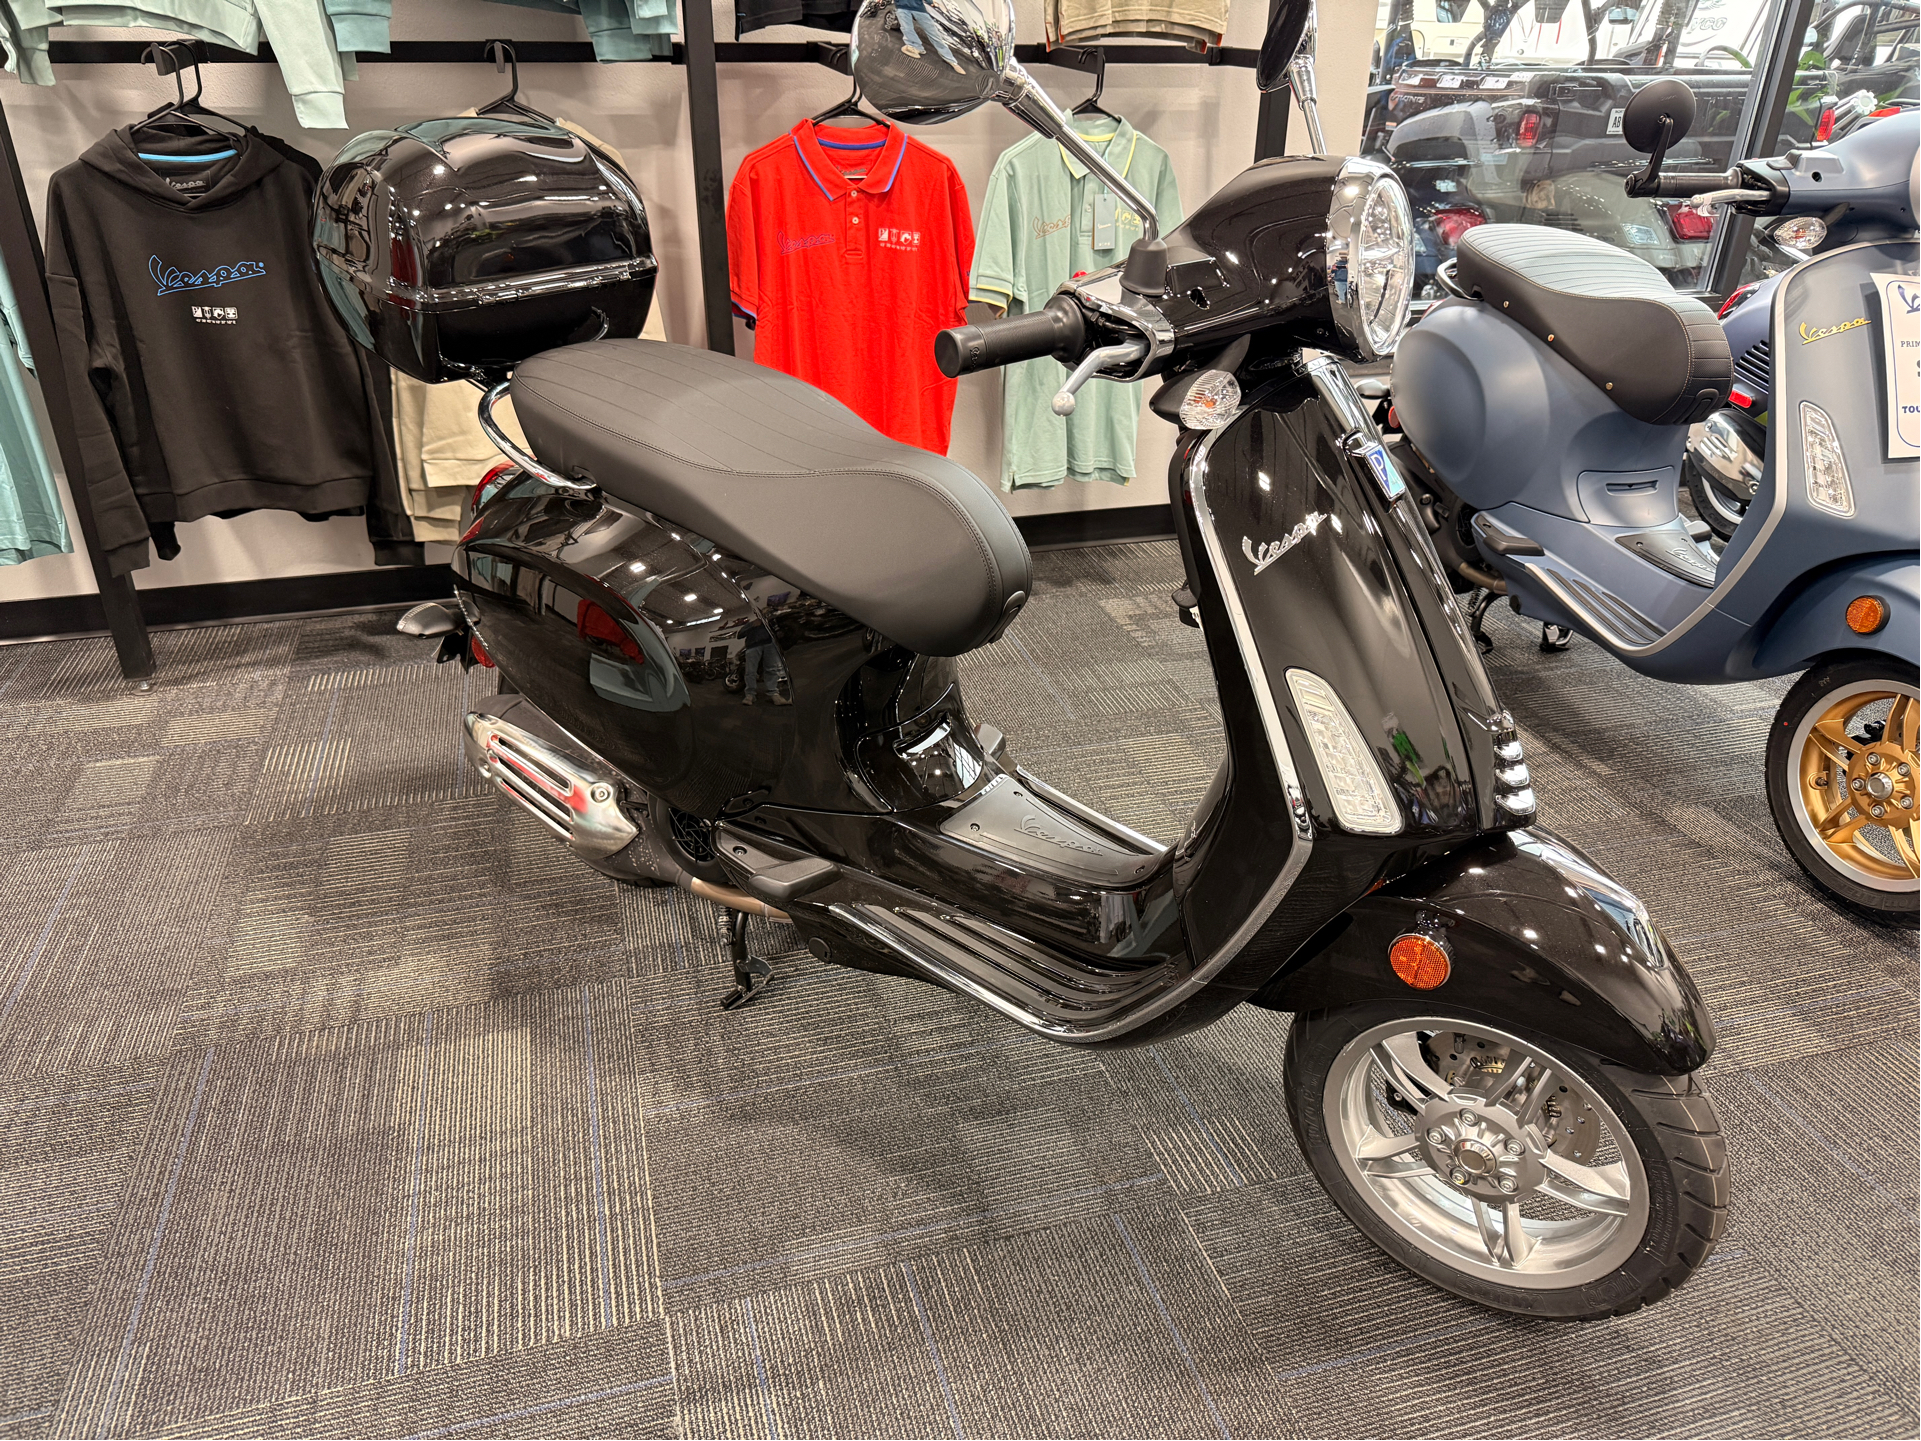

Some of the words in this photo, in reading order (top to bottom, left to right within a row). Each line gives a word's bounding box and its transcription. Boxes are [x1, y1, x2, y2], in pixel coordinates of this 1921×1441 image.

[776, 230, 836, 256] Vespa
[148, 254, 267, 297] Vespa
[1798, 317, 1872, 345] Vespa
[1241, 510, 1328, 576] Vespa
[1013, 813, 1104, 858] Vespa
